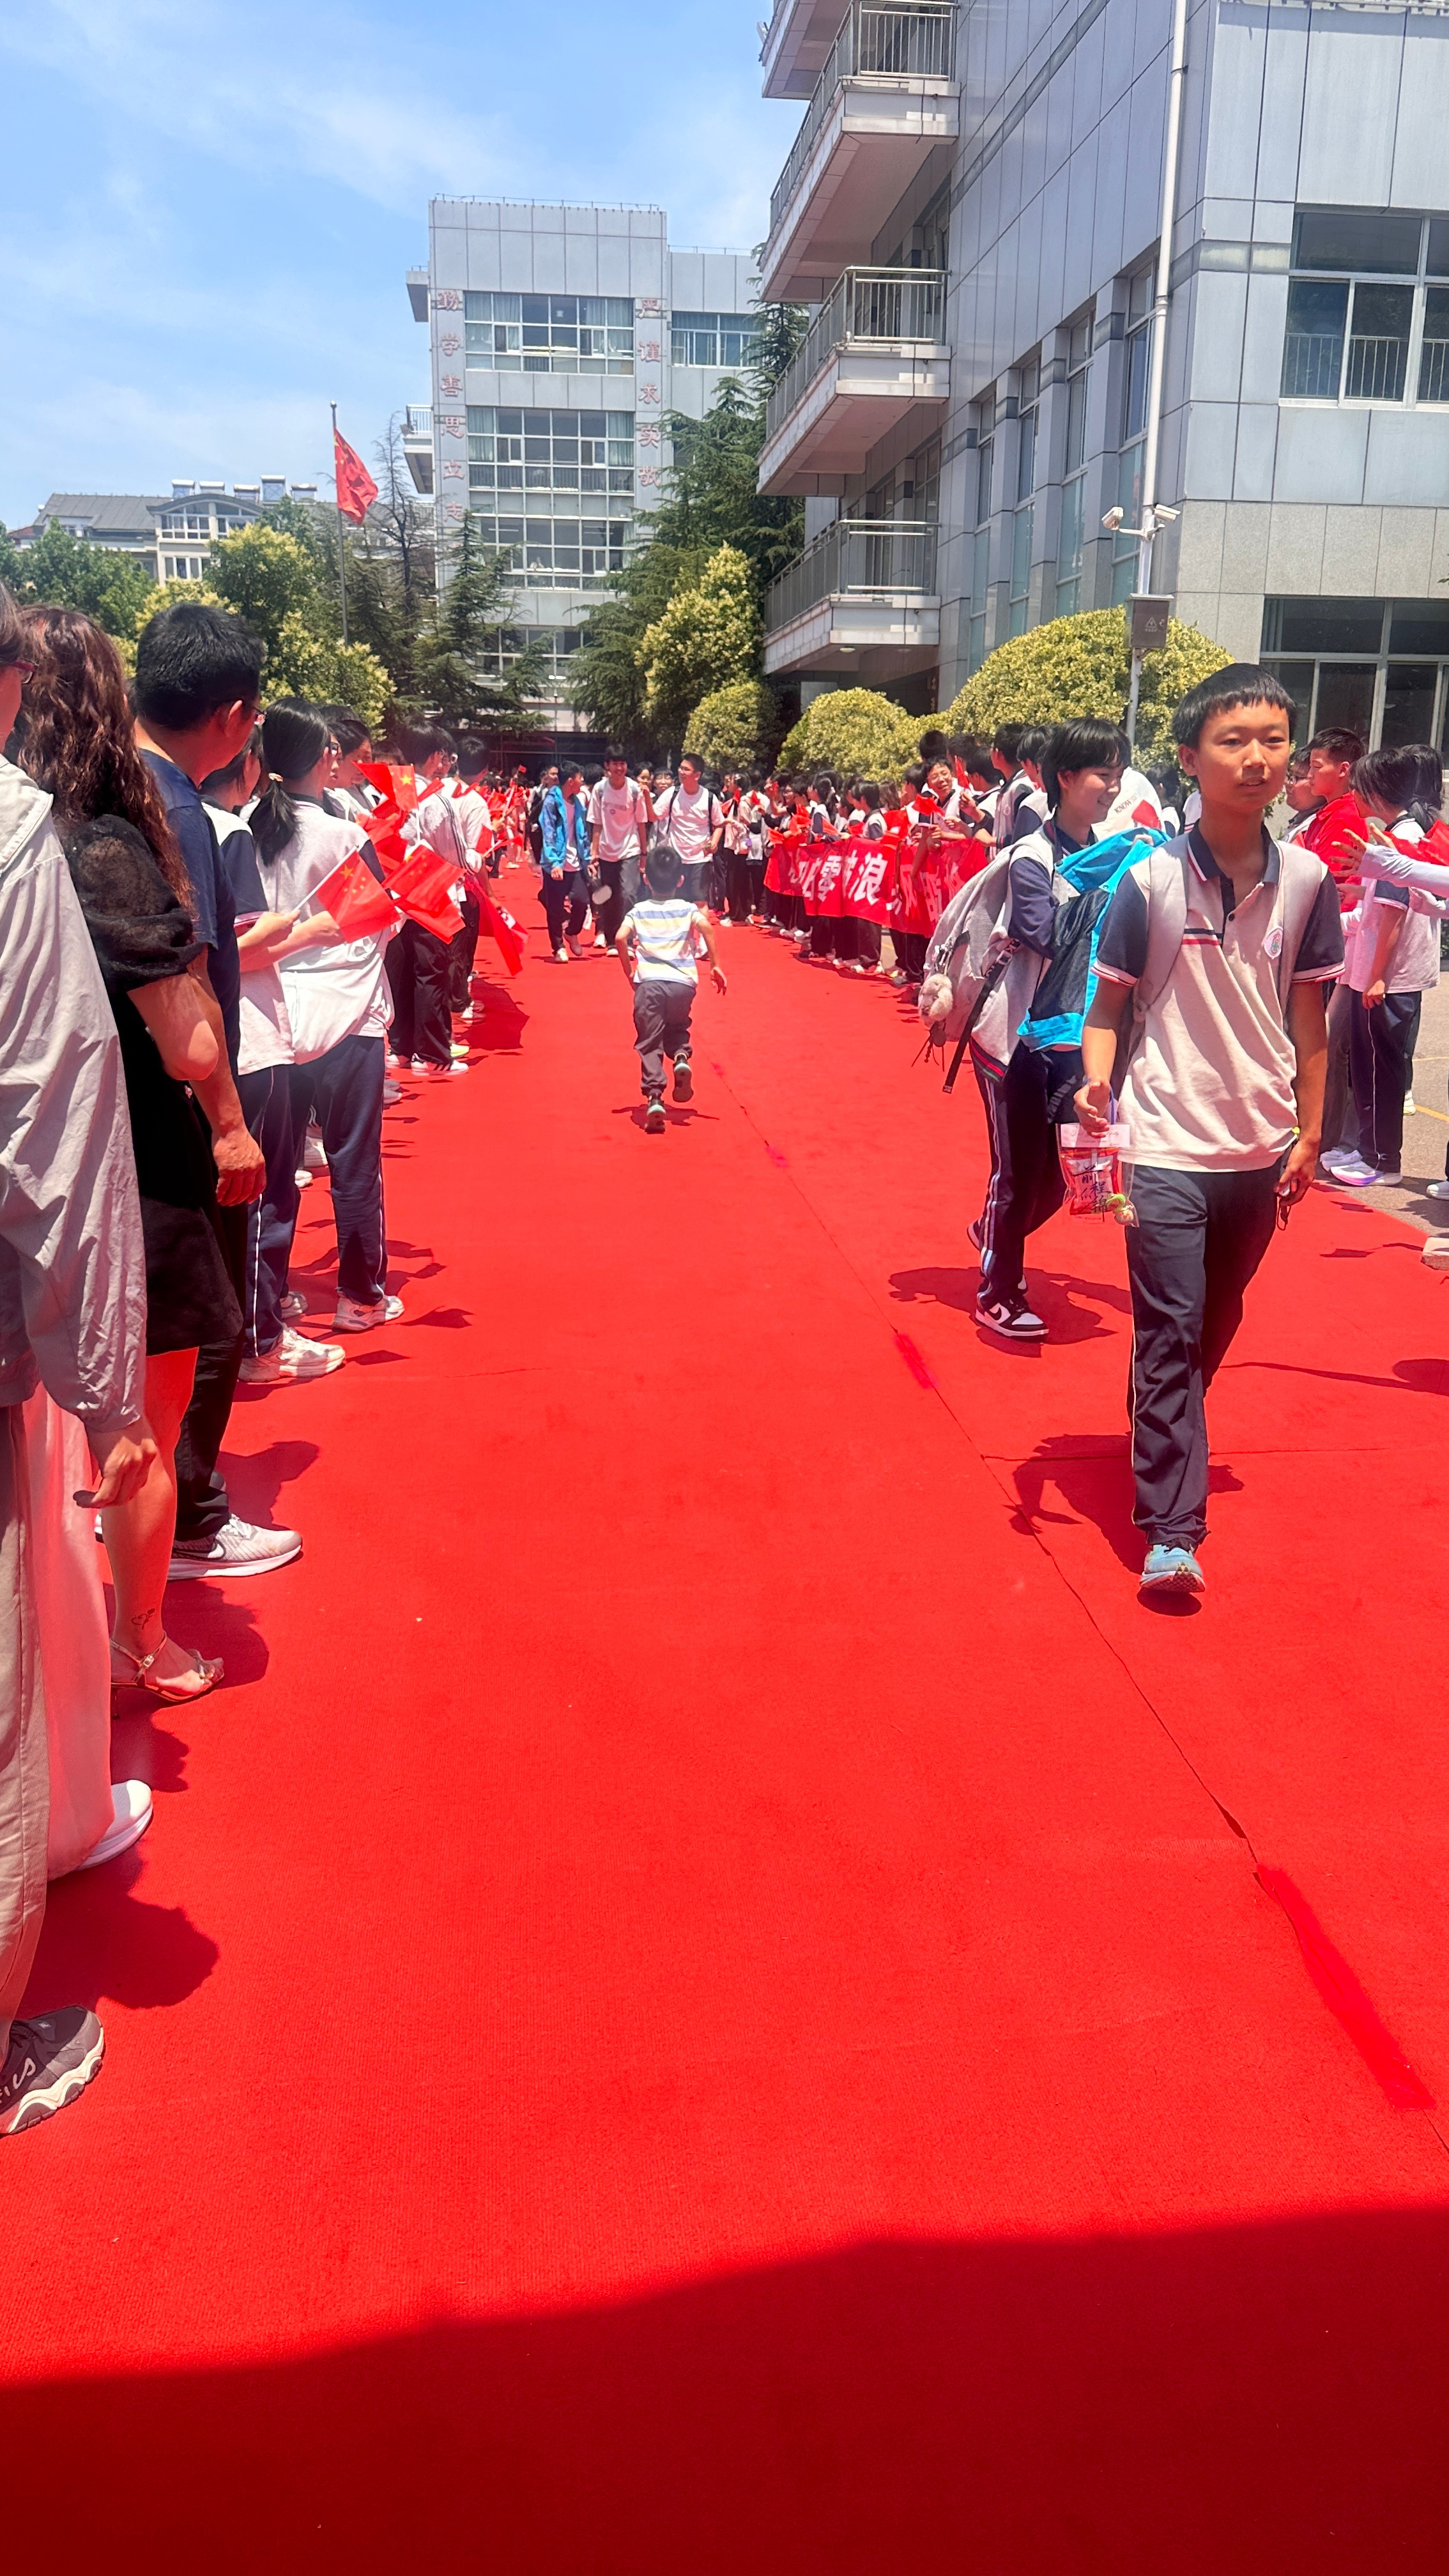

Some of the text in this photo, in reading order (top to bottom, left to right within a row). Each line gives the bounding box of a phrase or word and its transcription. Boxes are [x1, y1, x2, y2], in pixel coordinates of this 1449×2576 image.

[436, 289, 465, 564] 勤学善思立志
[1114, 799, 1131, 815] KNOW
[0, 2057, 36, 2104] ILA
